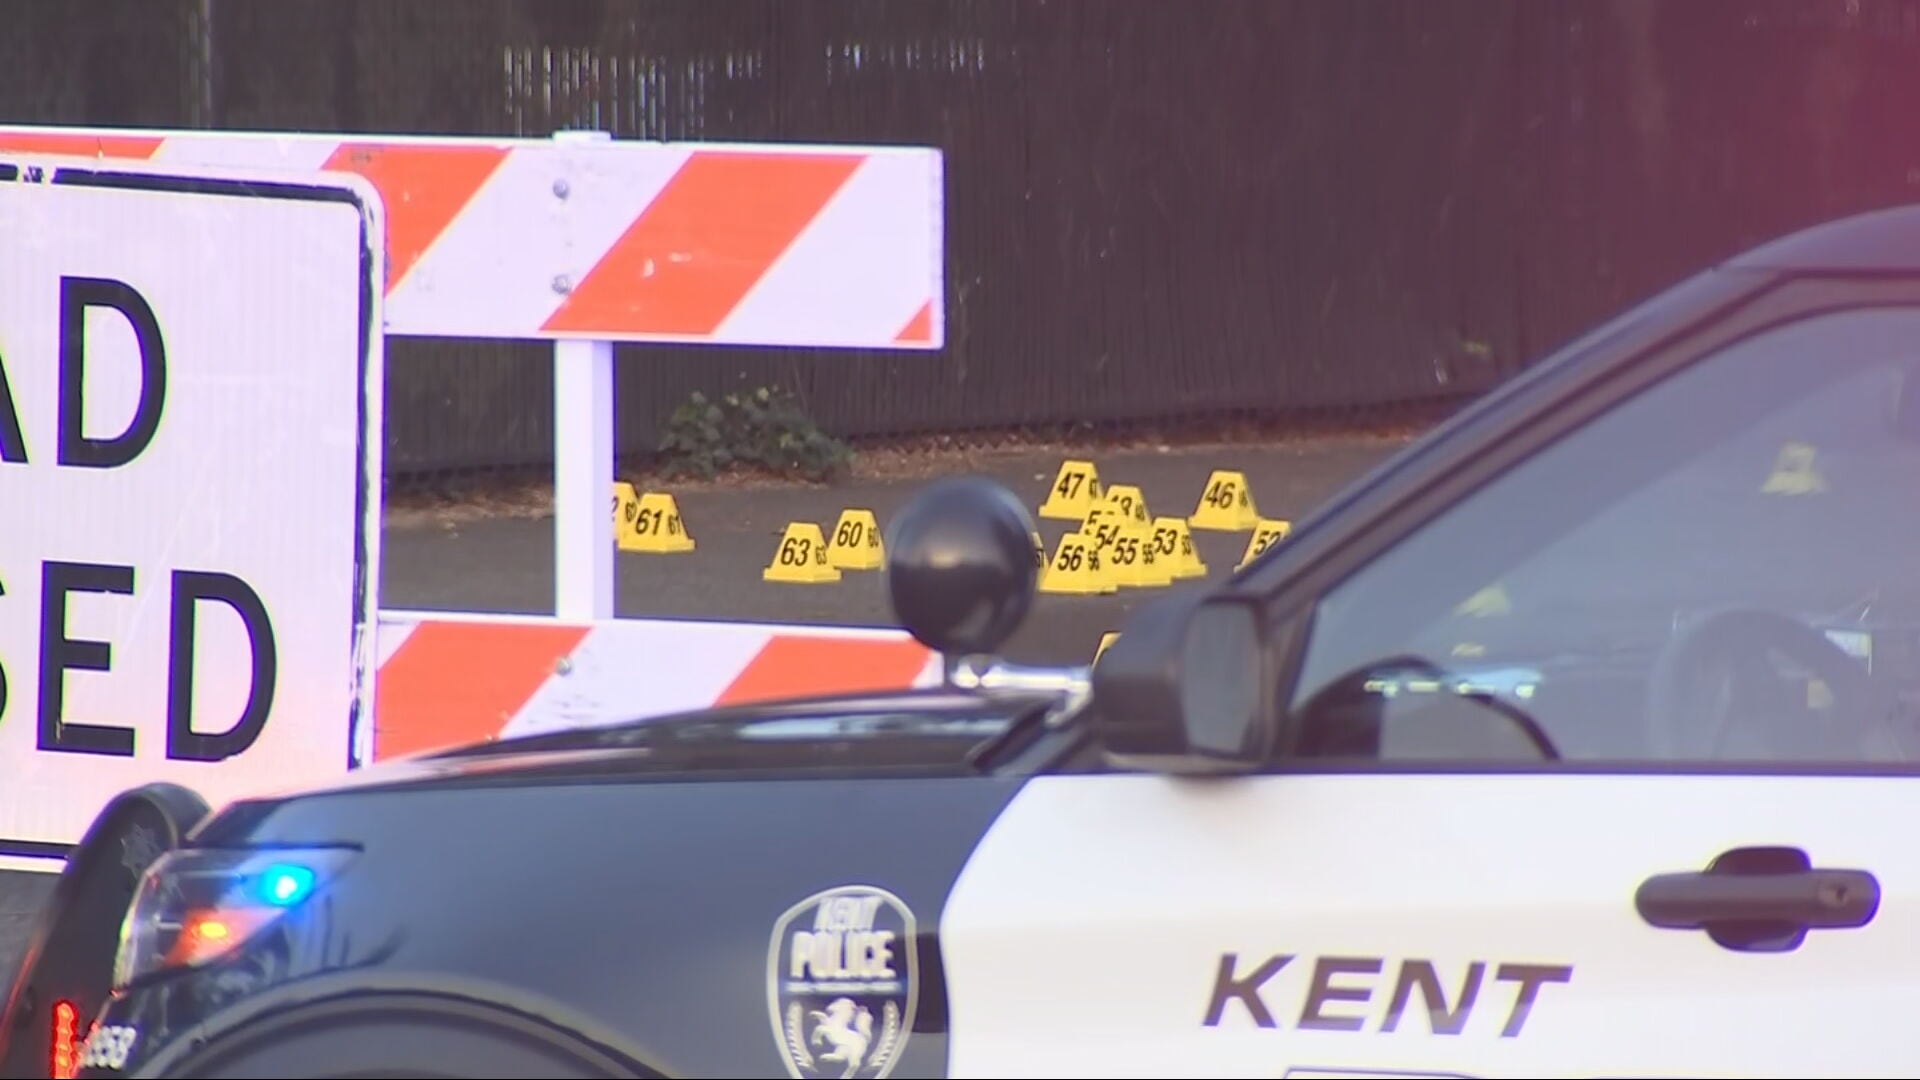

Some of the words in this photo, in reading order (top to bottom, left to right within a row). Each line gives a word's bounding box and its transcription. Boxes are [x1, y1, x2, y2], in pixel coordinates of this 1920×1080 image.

[0, 276, 167, 469] D
[1057, 471, 1085, 499] 47
[1204, 481, 1235, 509] 46
[635, 508, 663, 536] 61
[837, 520, 863, 548] 60
[1095, 524, 1120, 550] 54
[1111, 537, 1140, 565] 55
[1152, 528, 1178, 555] 53
[780, 537, 811, 566] 63
[1058, 545, 1084, 571] 56
[0, 560, 277, 762] ED
[789, 929, 898, 979] POLICE
[1201, 953, 1574, 1038] KENT
